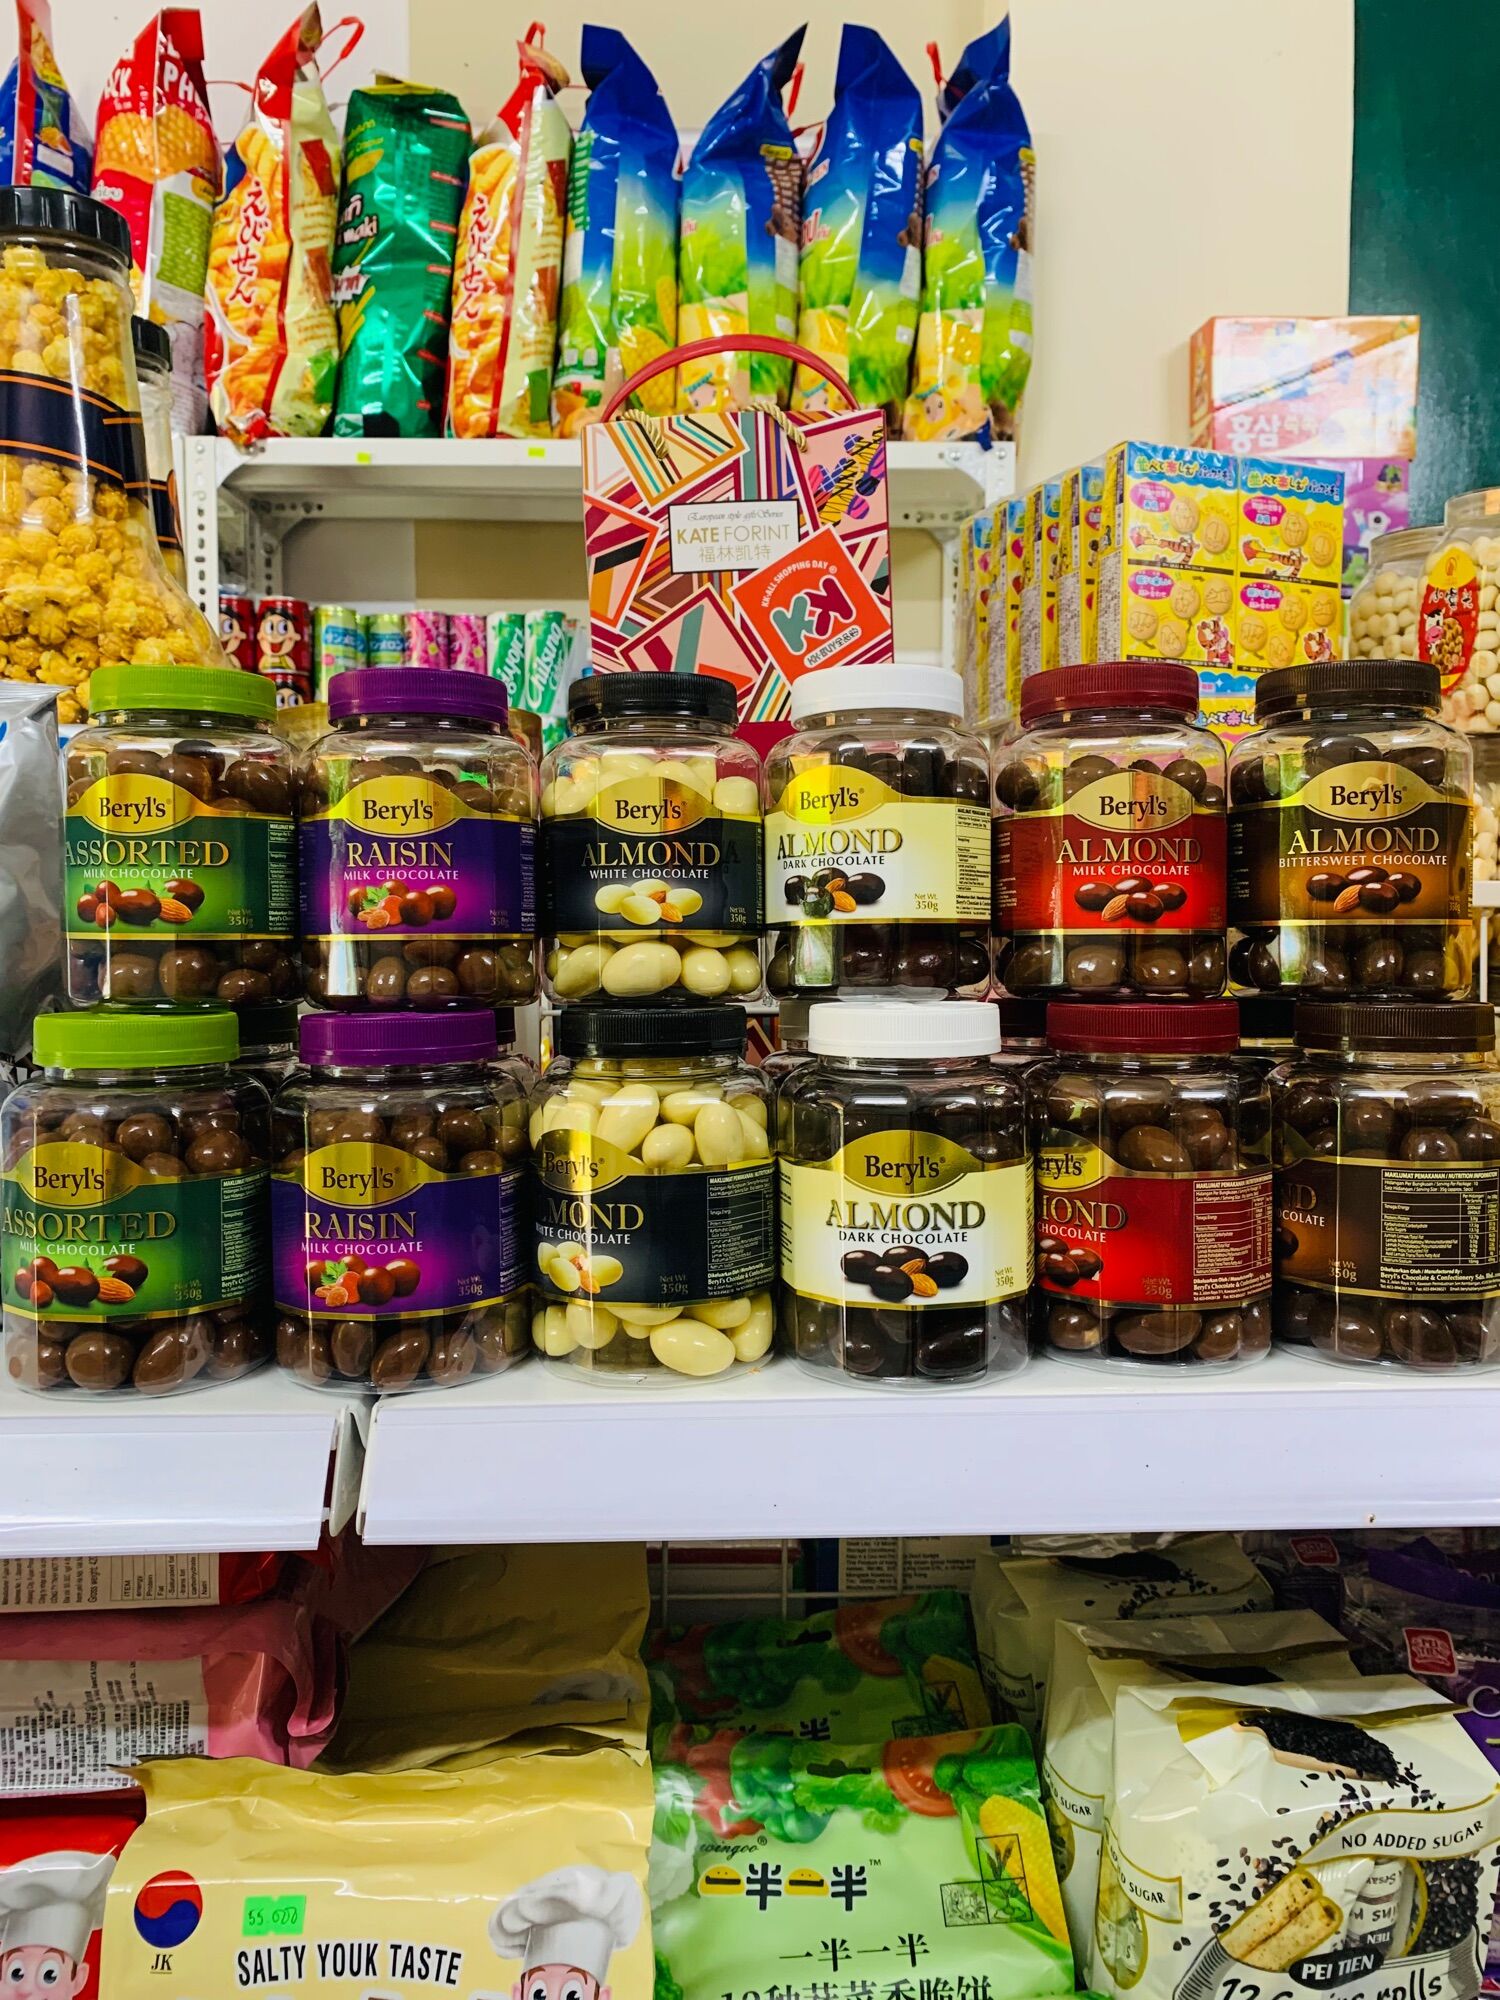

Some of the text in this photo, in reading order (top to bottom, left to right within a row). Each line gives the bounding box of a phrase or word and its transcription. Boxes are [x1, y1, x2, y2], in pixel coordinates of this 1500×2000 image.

[228, 179, 269, 304] えびせん
[452, 196, 491, 320] えびせん
[1227, 414, 1281, 452] 홍삼
[676, 524, 790, 544] KATE FORINT
[700, 545, 771, 562] 福林凯特
[773, 560, 811, 583] SHOPPING
[812, 560, 828, 569] DAY
[800, 787, 859, 814] Beryl's
[1099, 795, 1167, 822] Beryl's
[1330, 783, 1402, 812] Beryl's
[99, 796, 166, 824] Beryl's
[364, 798, 434, 826] Beryl's
[616, 798, 682, 825] Beryl's
[777, 828, 904, 861] ALMOND
[1056, 838, 1201, 864] ALMOND
[1288, 826, 1440, 854] ALMOND
[66, 840, 230, 867] ASSORTED
[347, 842, 454, 868] RAISIN
[582, 841, 721, 867] ALMOND
[783, 856, 885, 870] DARK CHOCOLATE
[1279, 854, 1448, 868] BITTERSWEET CHOCOLATE
[84, 868, 193, 879] MILK CHOCOLATE
[344, 870, 459, 881] MILK CHOCOLATE
[590, 868, 709, 879] WHITE CHOCOLATE
[1072, 864, 1190, 876] MILK CHOCOLATE
[914, 892, 926, 900] Net
[916, 901, 938, 912] 350g
[730, 914, 746, 924] 350g
[544, 1150, 599, 1183] Beryl's
[865, 1155, 940, 1186] Beryl's
[1384, 1171, 1414, 1179] MAKLUMAT
[1414, 1172, 1446, 1180] PEMAKANAN
[34, 1166, 105, 1196] Beryl's
[321, 1166, 394, 1196] Beryl's
[2, 1206, 176, 1242] ASSORTED
[543, 1197, 644, 1230] MOND
[826, 1199, 986, 1232] ALMOND
[304, 1212, 416, 1241] RAISIN
[557, 1228, 631, 1246] CHOCOLATE
[839, 1230, 968, 1245] DARK CHOCOLATE
[19, 1240, 136, 1256] MILK CHOCOLATE
[301, 1242, 423, 1254] MILK CHOCOLATE
[1328, 1258, 1357, 1270] Net Wt.
[1328, 1267, 1357, 1282] 350g
[1380, 1266, 1409, 1274] Dikeluarkan
[660, 1275, 672, 1284] Net
[708, 1278, 726, 1286] Beryl's
[996, 1276, 1014, 1288] 350g
[1380, 1272, 1400, 1280] Beryl's
[1436, 1274, 1474, 1282] Confectionery
[458, 1284, 483, 1296] 350g
[661, 1283, 689, 1295] 350g
[1144, 1284, 1172, 1299] 350g
[146, 1574, 154, 1596] Protein
[1060, 1796, 1092, 1816] SUGAR
[1342, 1820, 1485, 1852] NO ADDED SUGAR
[705, 1862, 868, 1912] 一半一半
[1128, 1882, 1166, 1904] SUGAR
[1367, 1932, 1390, 1944] TIEN
[151, 1954, 174, 1971] JK
[778, 1933, 930, 1972] 一半一半
[238, 1942, 462, 1987] SALTY YOUK TASTE
[1302, 1954, 1375, 1981] PEI TIEN
